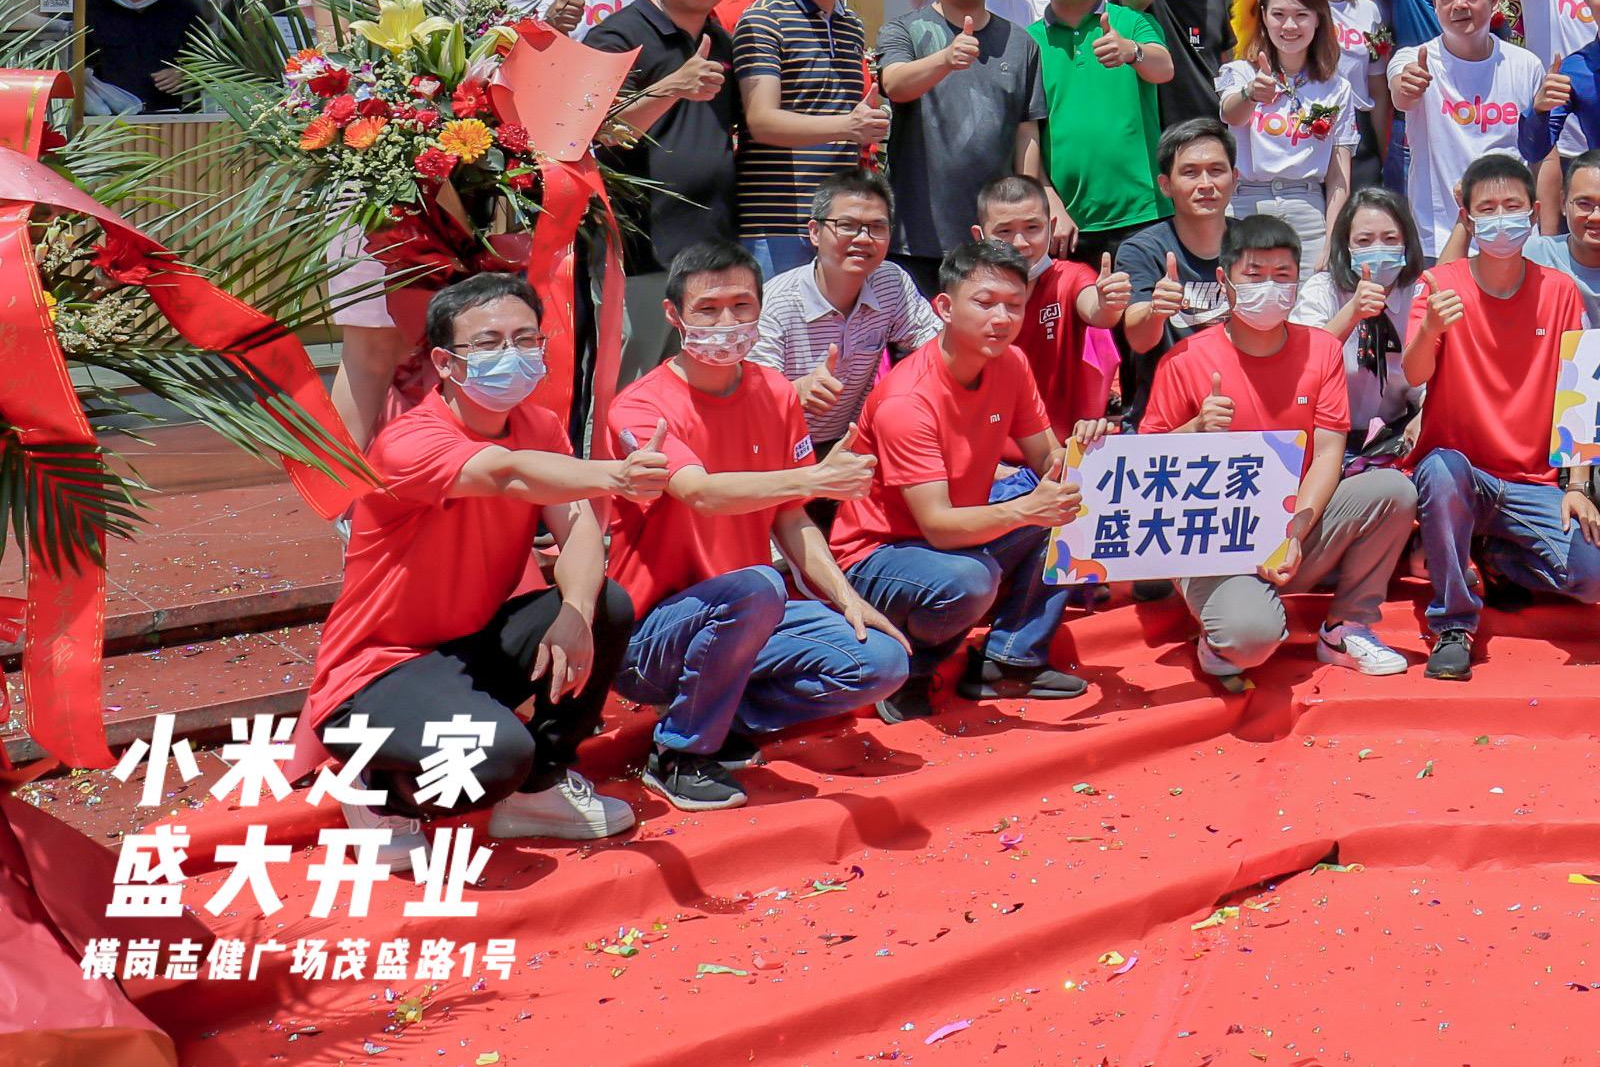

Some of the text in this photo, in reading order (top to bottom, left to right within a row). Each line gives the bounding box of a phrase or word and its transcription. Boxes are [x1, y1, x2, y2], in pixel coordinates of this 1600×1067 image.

[1097, 454, 1265, 504] 小米之家
[1092, 506, 1261, 560] 盛大开业
